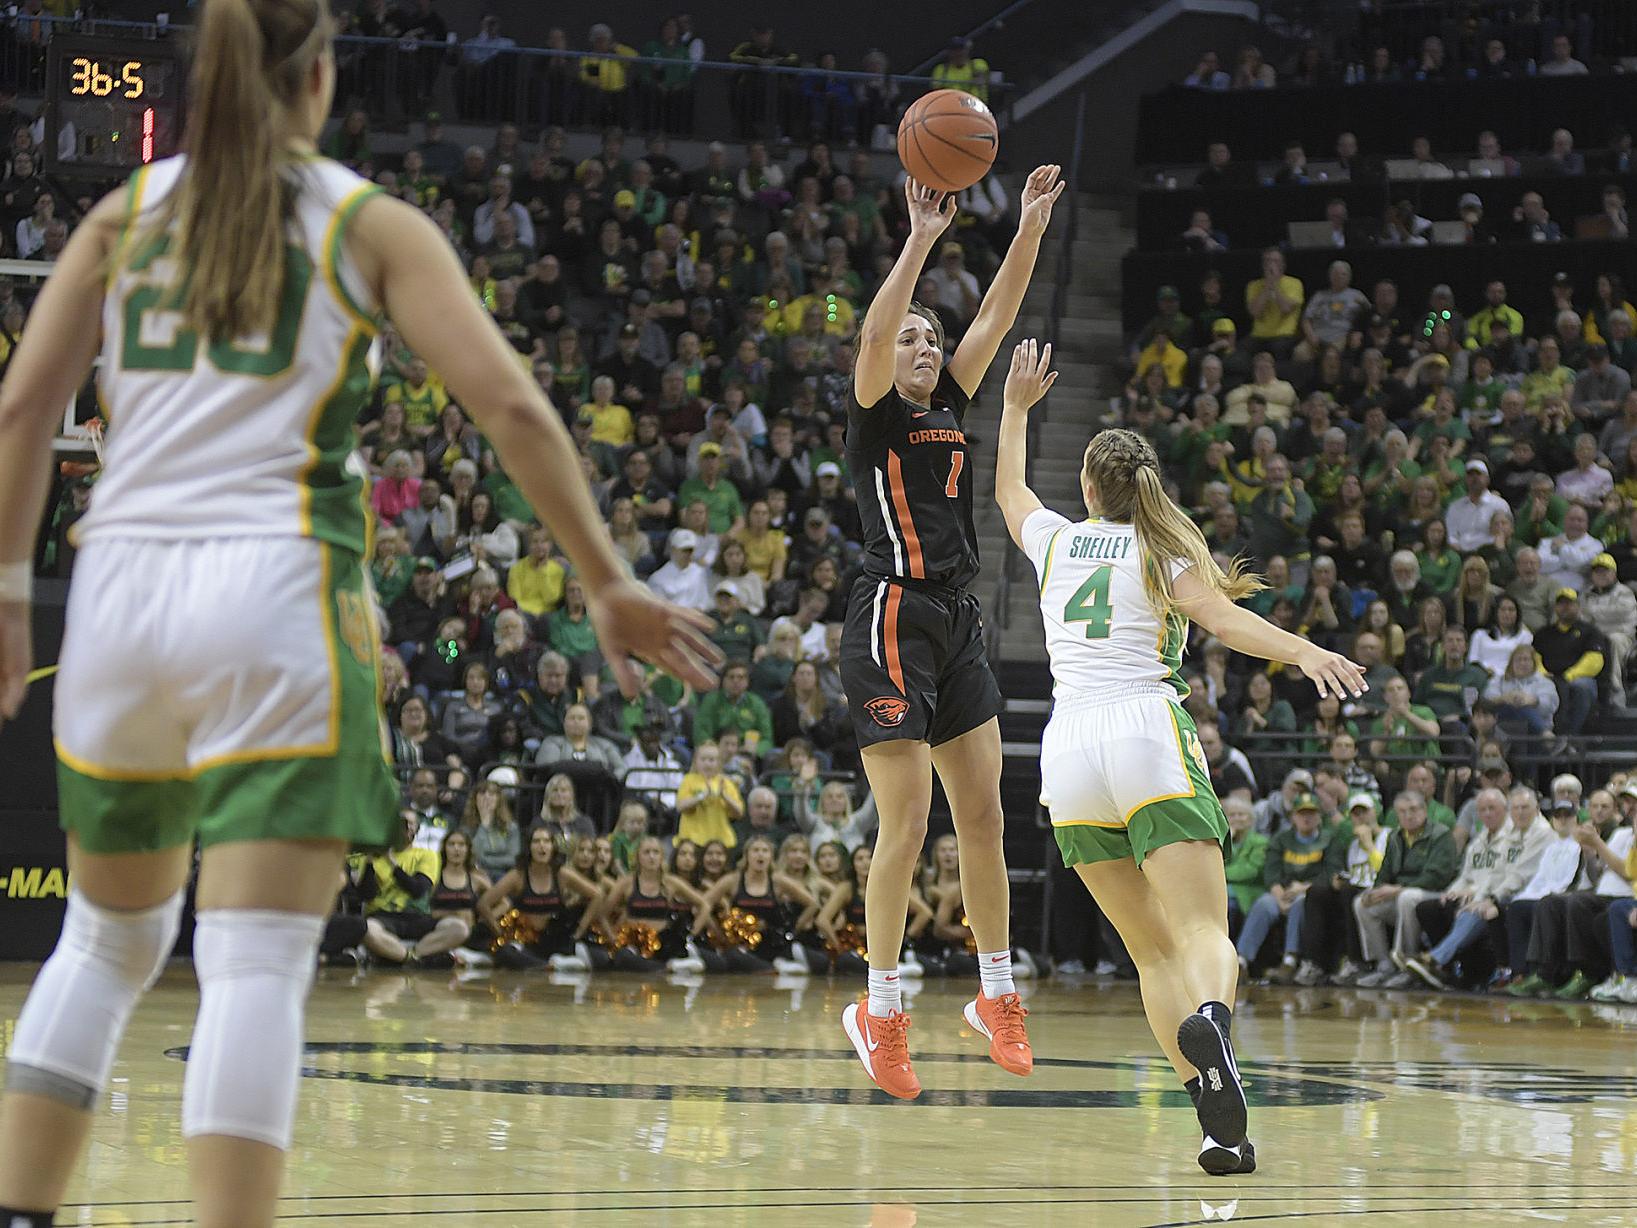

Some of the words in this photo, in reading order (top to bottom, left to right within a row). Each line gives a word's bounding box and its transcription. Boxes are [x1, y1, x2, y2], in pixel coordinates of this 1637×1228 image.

[142, 107, 154, 163] 1
[908, 429, 967, 445] OREGON
[945, 450, 964, 498] 1
[1069, 535, 1132, 559] SHELLEY
[1063, 565, 1114, 639] 4
